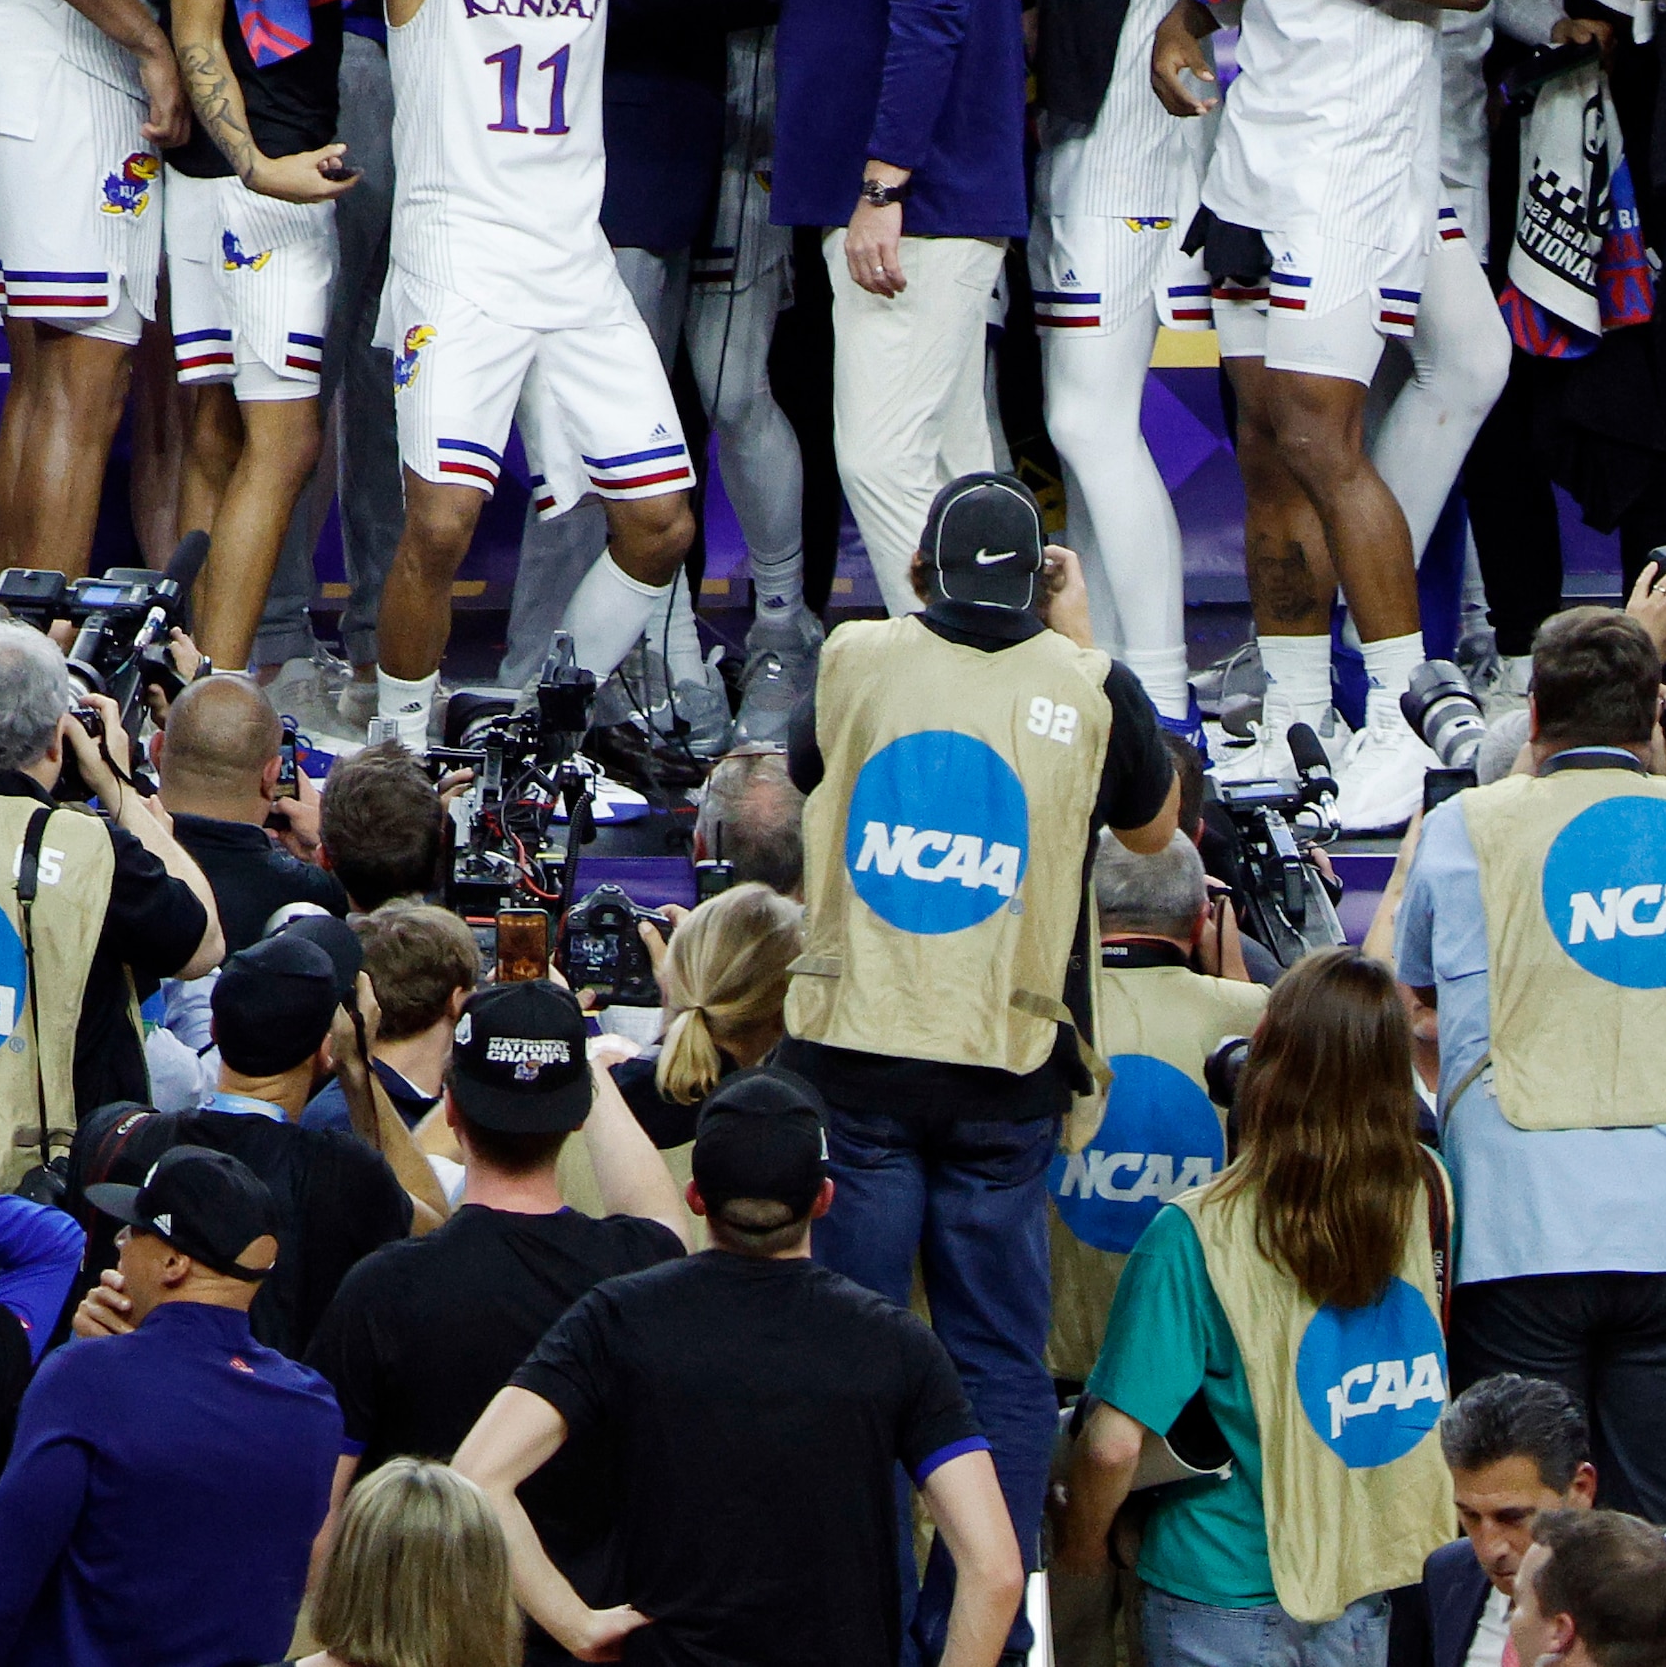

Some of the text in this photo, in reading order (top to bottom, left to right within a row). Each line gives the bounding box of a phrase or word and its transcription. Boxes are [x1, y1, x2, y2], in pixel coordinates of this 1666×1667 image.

[483, 44, 570, 135] 11
[1518, 224, 1597, 287] ATIONAL
[1027, 695, 1078, 745] 92
[856, 820, 1020, 896] NCAA
[486, 1050, 571, 1064] CHAMPS
[488, 1041, 570, 1053] NATIONAL
